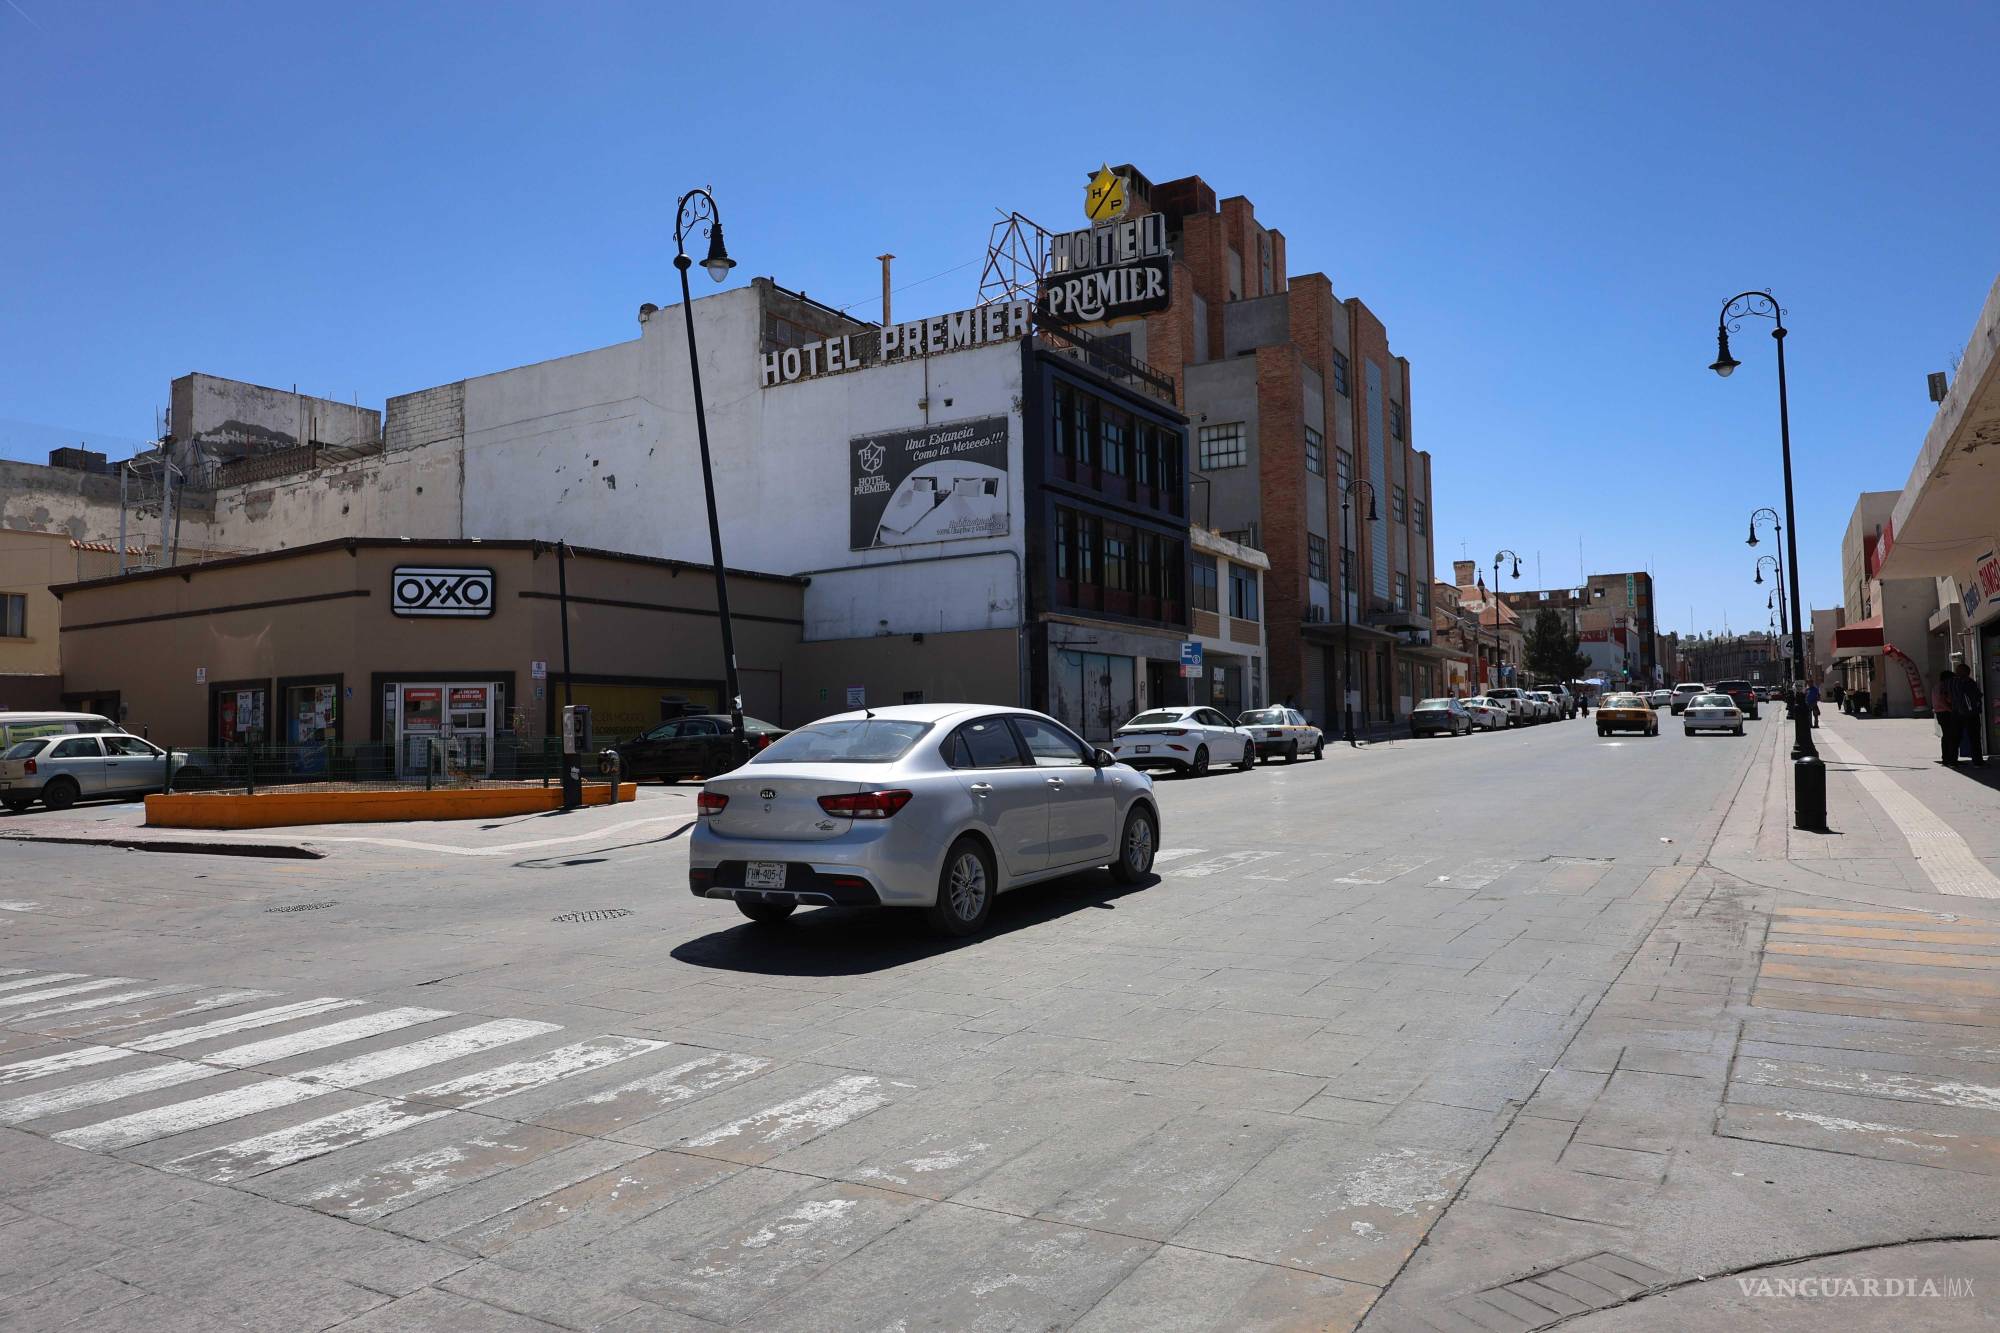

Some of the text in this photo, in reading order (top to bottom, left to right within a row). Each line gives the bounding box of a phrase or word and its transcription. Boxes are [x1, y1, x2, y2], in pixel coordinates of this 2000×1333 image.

[1092, 188, 1102, 199] H
[1111, 199, 1122, 210] P
[1054, 214, 1161, 273] HOTEL
[1047, 267, 1166, 321] PREMIER
[761, 301, 1030, 386] HOTEL PREMIER
[905, 426, 974, 451] Una Estancia
[913, 431, 1004, 461] Como la Mereces!!!
[854, 483, 891, 495] PREMIER
[858, 475, 887, 487] HOTEL
[397, 578, 489, 606] OXXO
[1182, 643, 1193, 658] E
